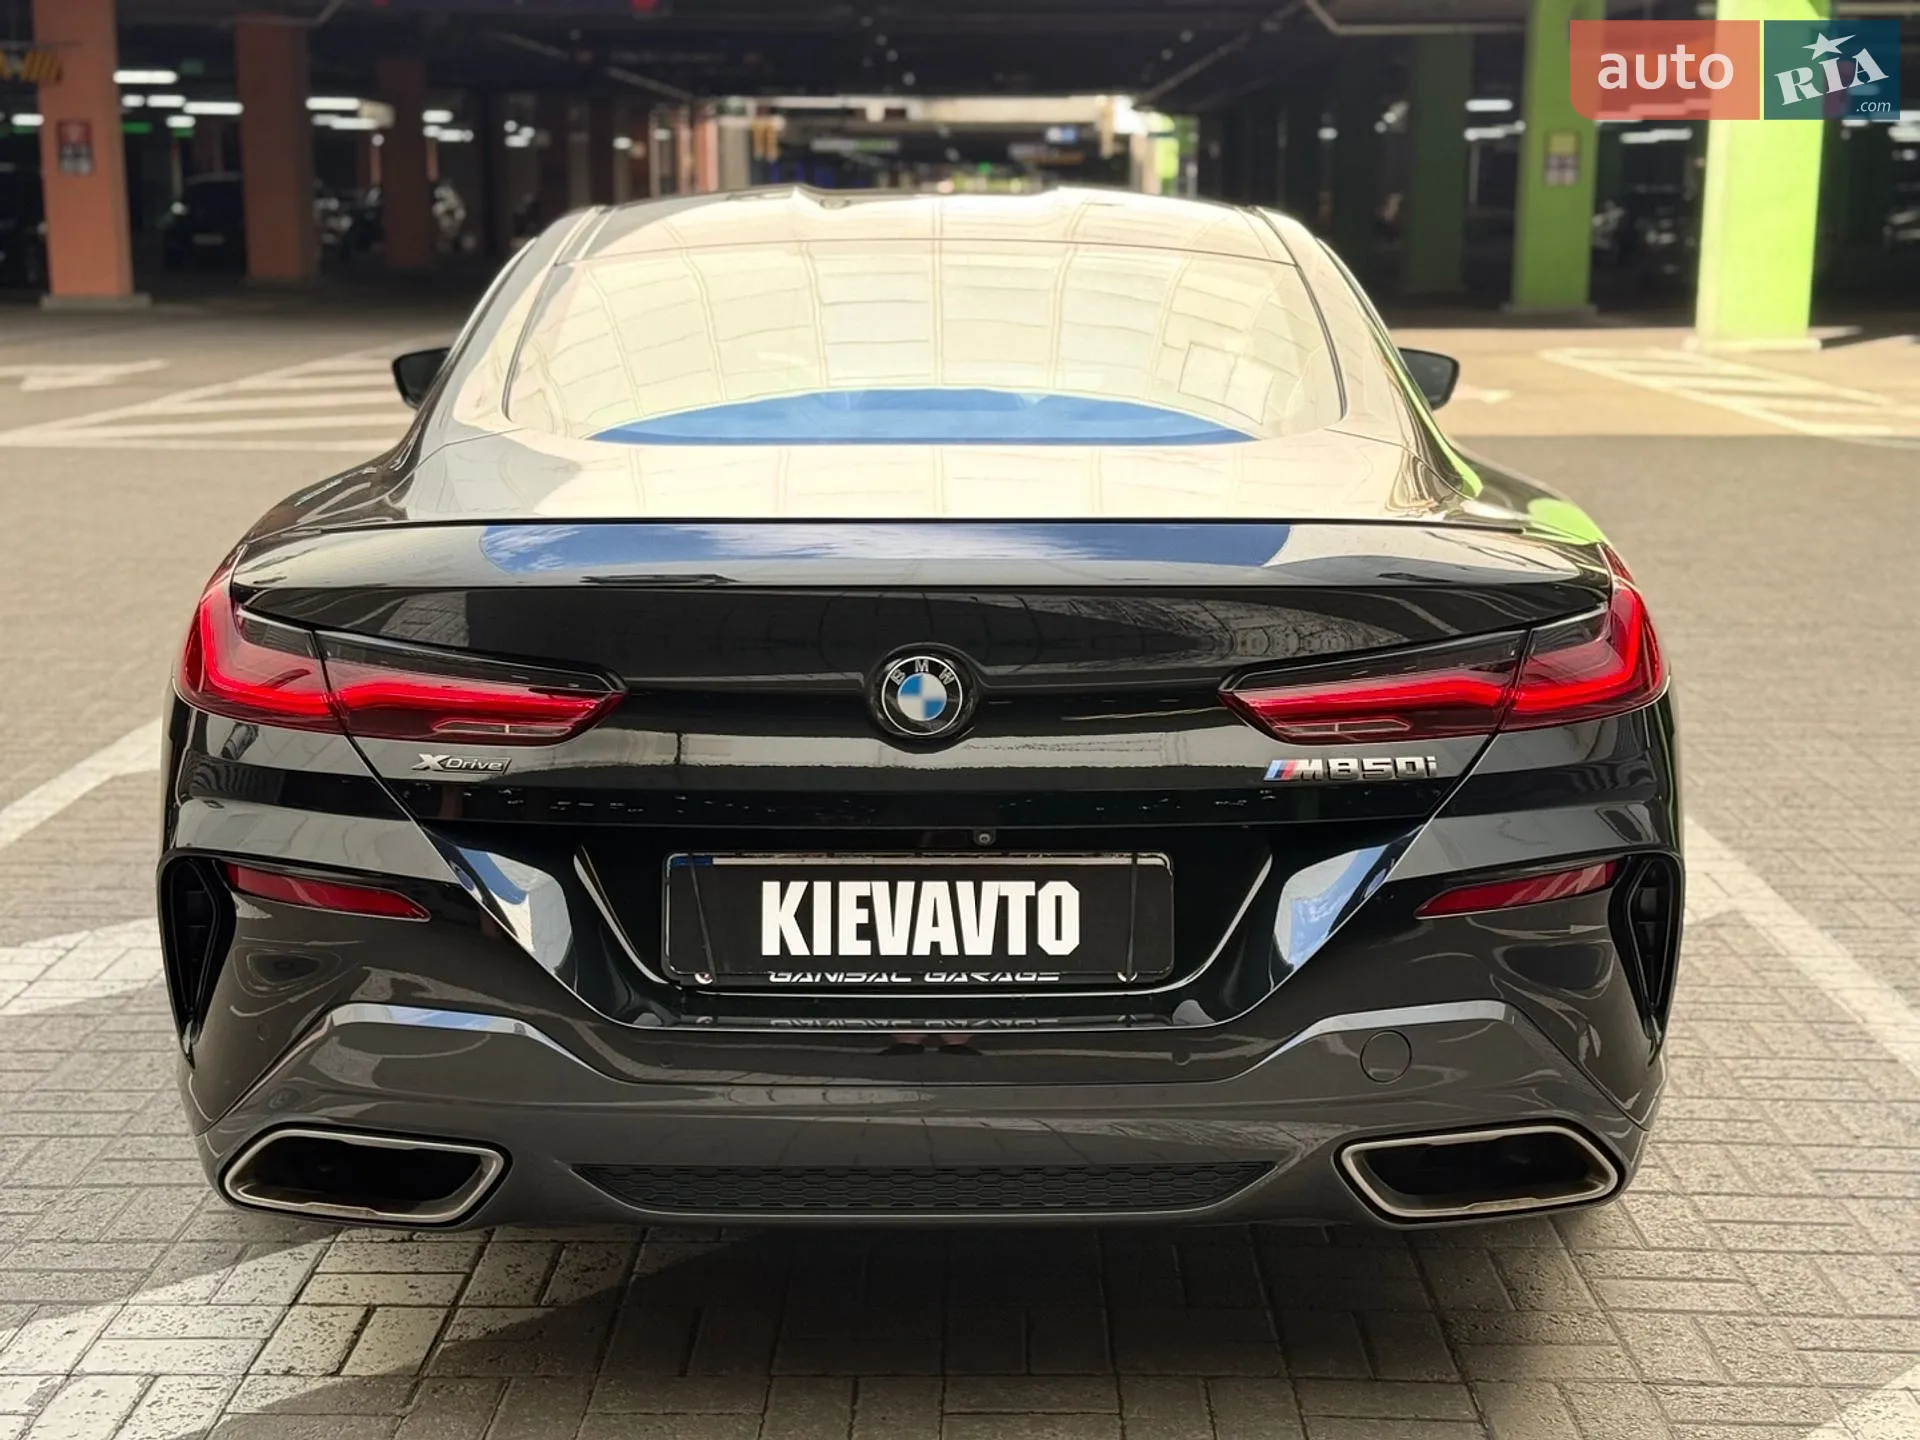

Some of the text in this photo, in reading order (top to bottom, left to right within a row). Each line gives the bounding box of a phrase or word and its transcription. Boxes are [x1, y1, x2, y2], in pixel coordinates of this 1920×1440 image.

[889, 658, 955, 686] BMW
[1293, 756, 1437, 781] M850i
[761, 880, 1080, 956] KIEVAVTO
